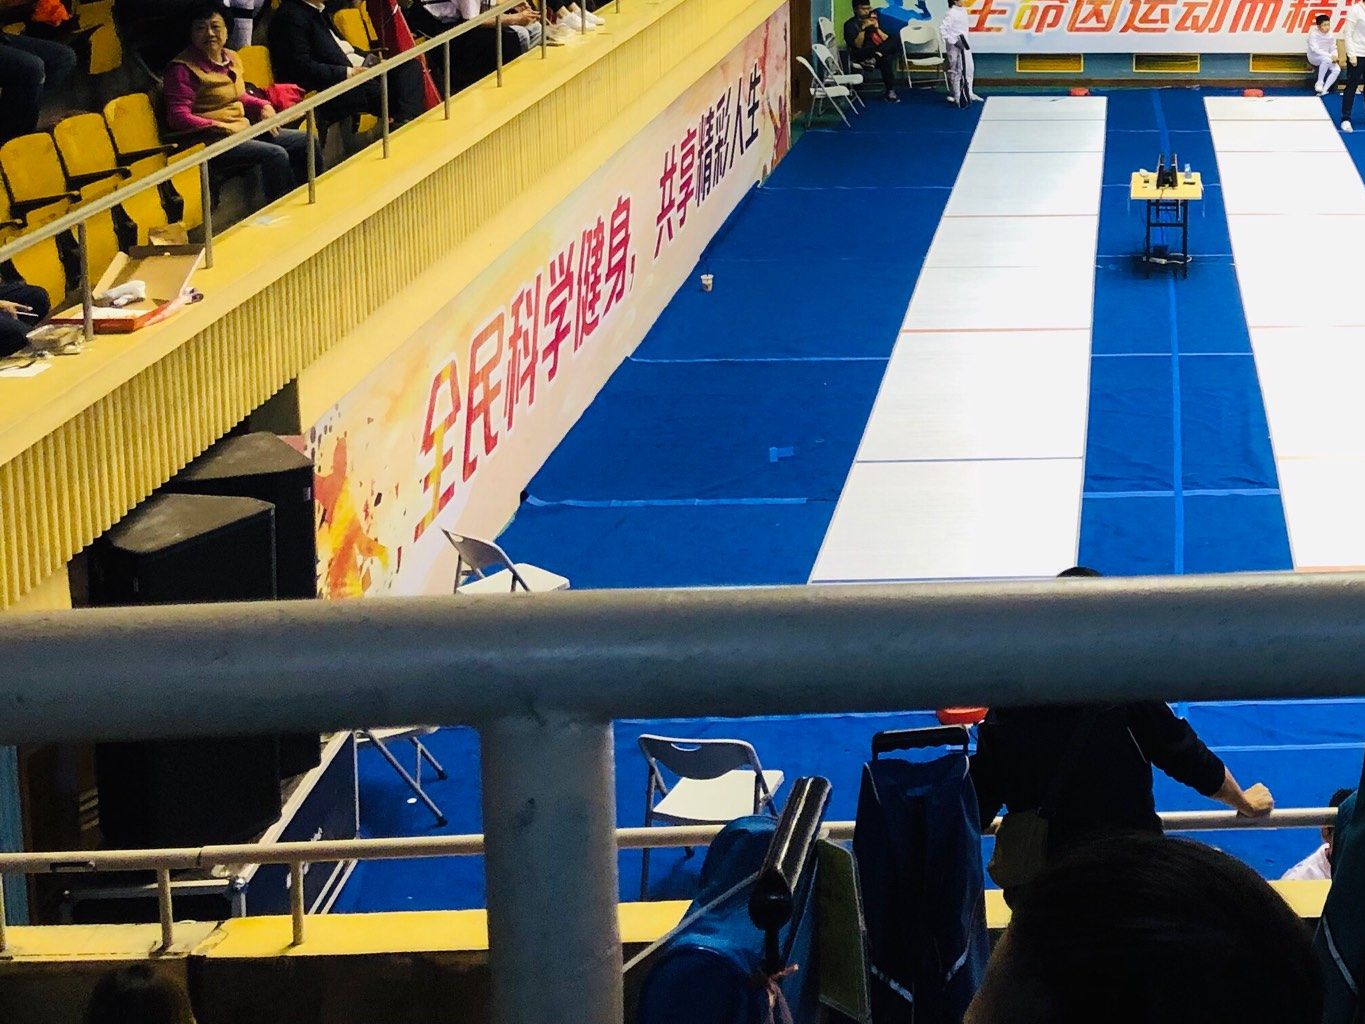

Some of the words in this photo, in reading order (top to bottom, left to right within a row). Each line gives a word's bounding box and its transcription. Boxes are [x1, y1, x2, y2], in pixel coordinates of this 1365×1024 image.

[654, 62, 761, 259] 共享精彩人生
